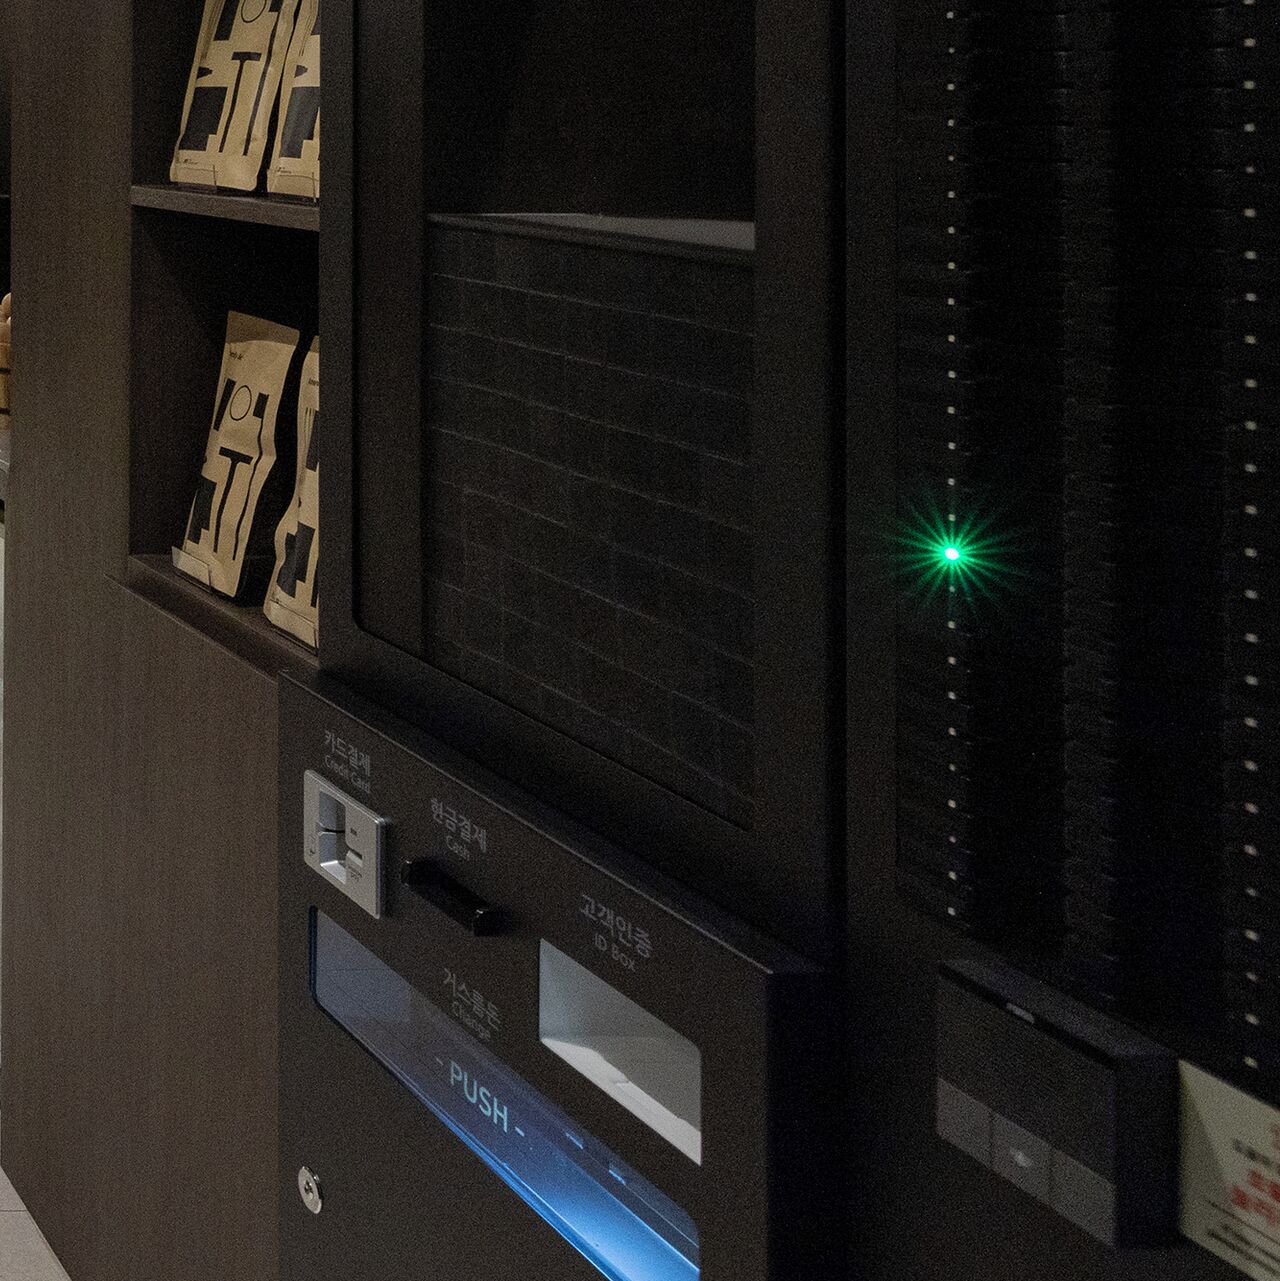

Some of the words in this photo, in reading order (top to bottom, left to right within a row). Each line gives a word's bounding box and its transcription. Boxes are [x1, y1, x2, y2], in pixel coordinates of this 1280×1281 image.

[431, 798, 487, 854] 현금결제
[578, 893, 654, 959] 고객인증
[593, 932, 608, 952] ID
[611, 942, 637, 972] Box
[443, 967, 502, 1032] 거스름돈
[449, 1059, 509, 1134] PUSH
